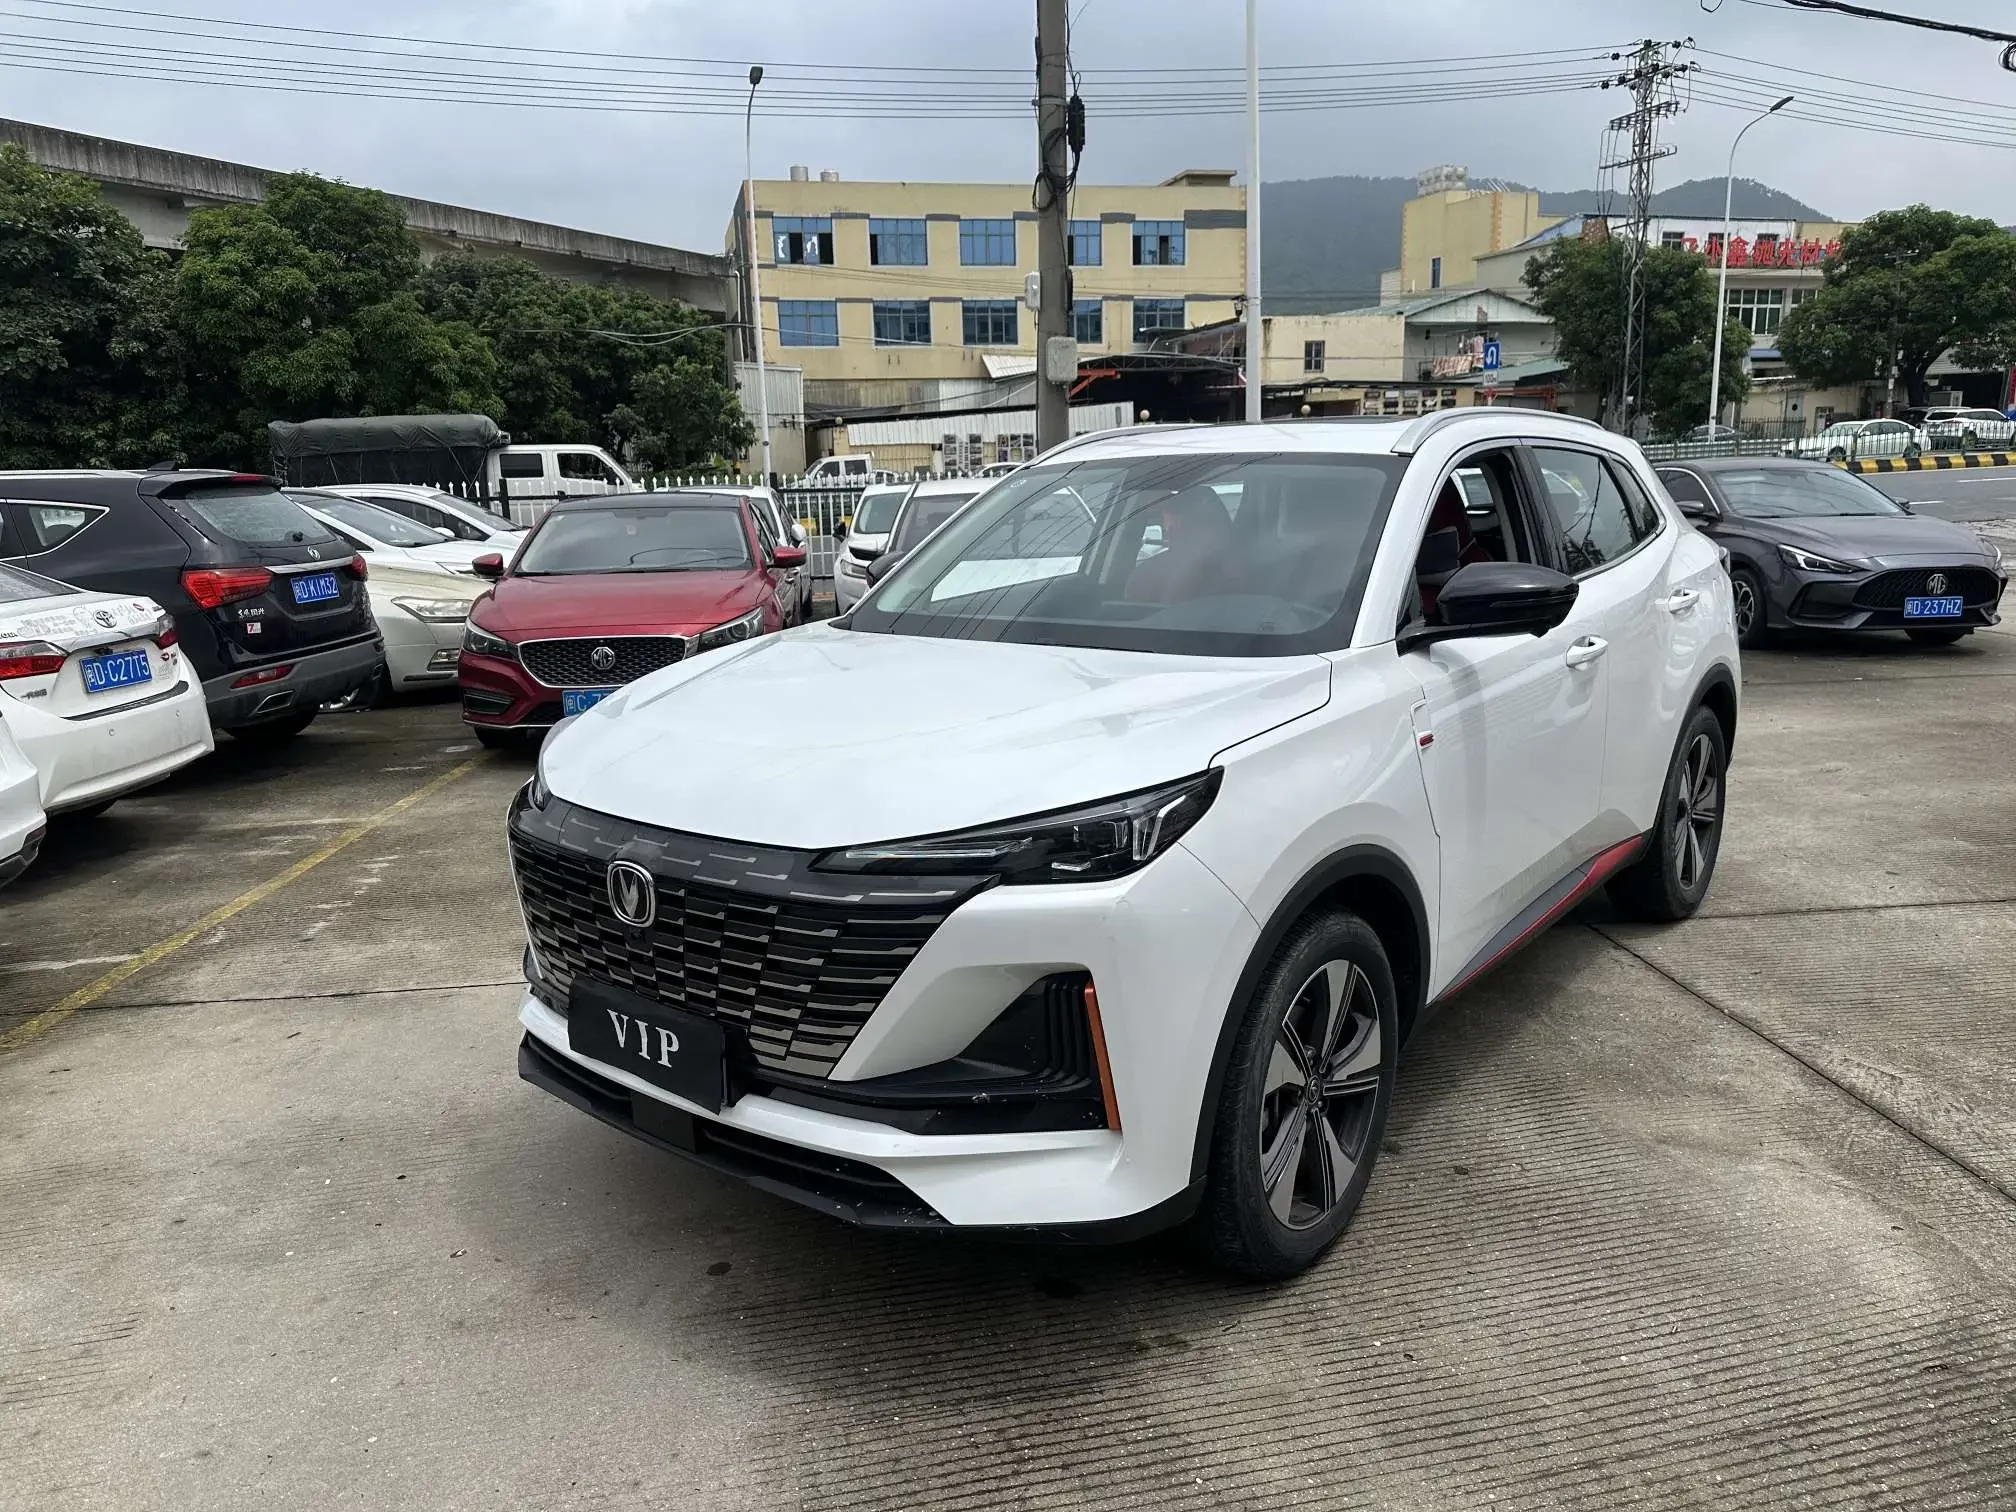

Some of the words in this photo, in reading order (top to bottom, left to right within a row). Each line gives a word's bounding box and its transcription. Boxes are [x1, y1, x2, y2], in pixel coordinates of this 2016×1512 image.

[1927, 574, 1947, 595] MG
[592, 647, 615, 670] MG
[606, 1009, 680, 1068] VIP
